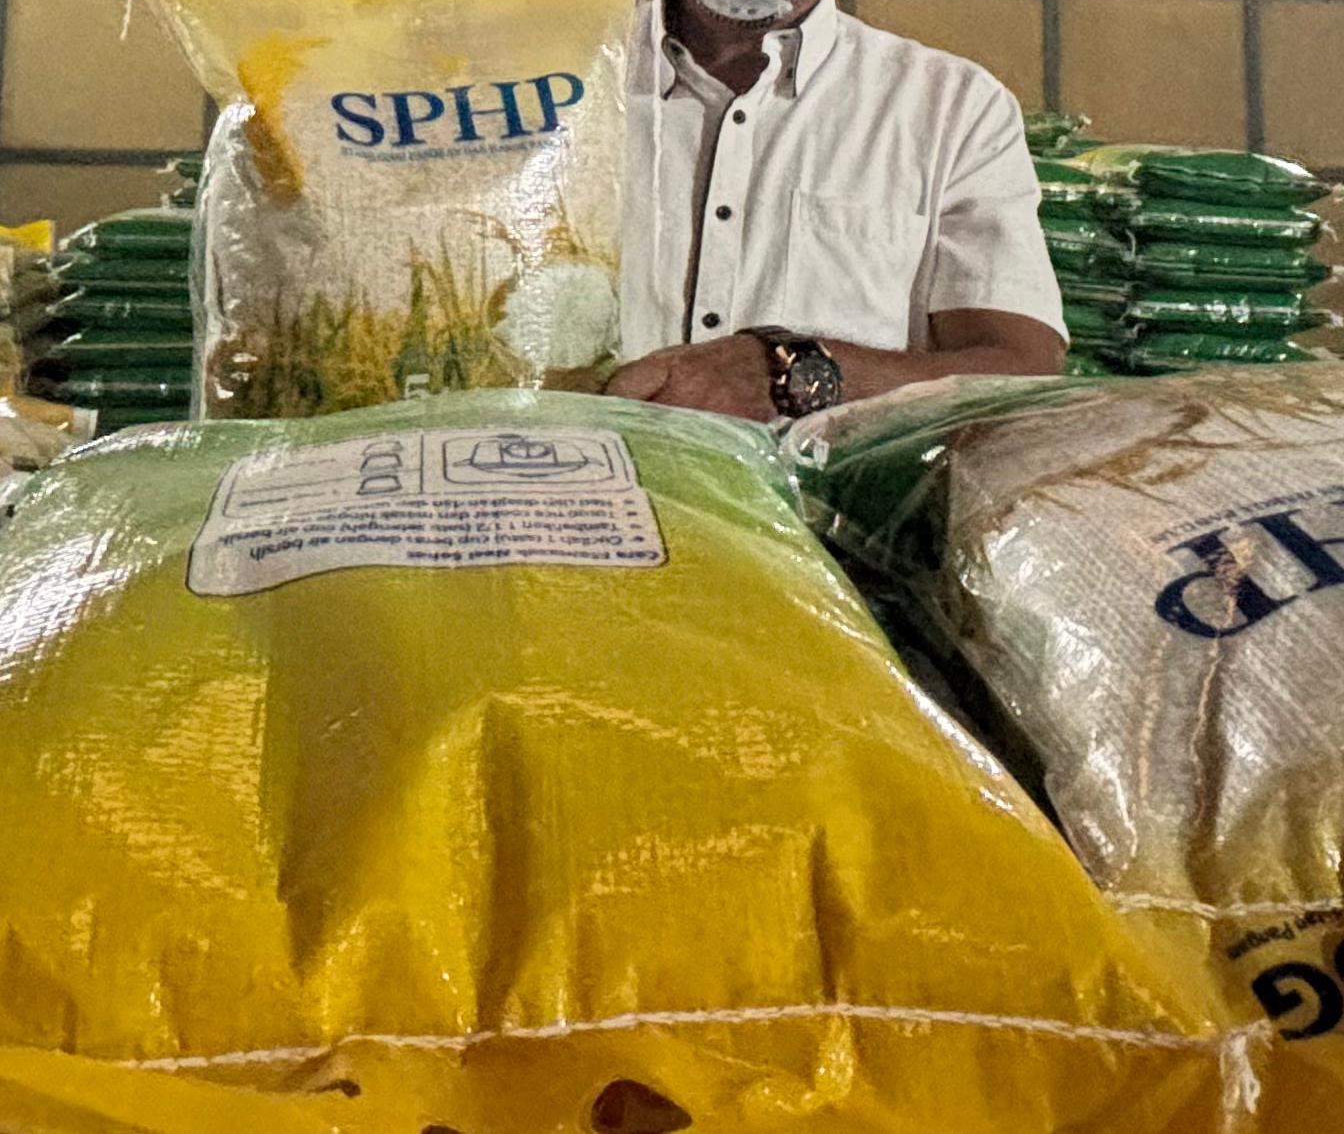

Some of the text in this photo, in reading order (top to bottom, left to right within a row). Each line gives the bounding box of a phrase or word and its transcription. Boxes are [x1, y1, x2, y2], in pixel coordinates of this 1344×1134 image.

[330, 71, 585, 149] SPHP
[250, 538, 304, 562] bersih
[334, 534, 402, 546] dengan
